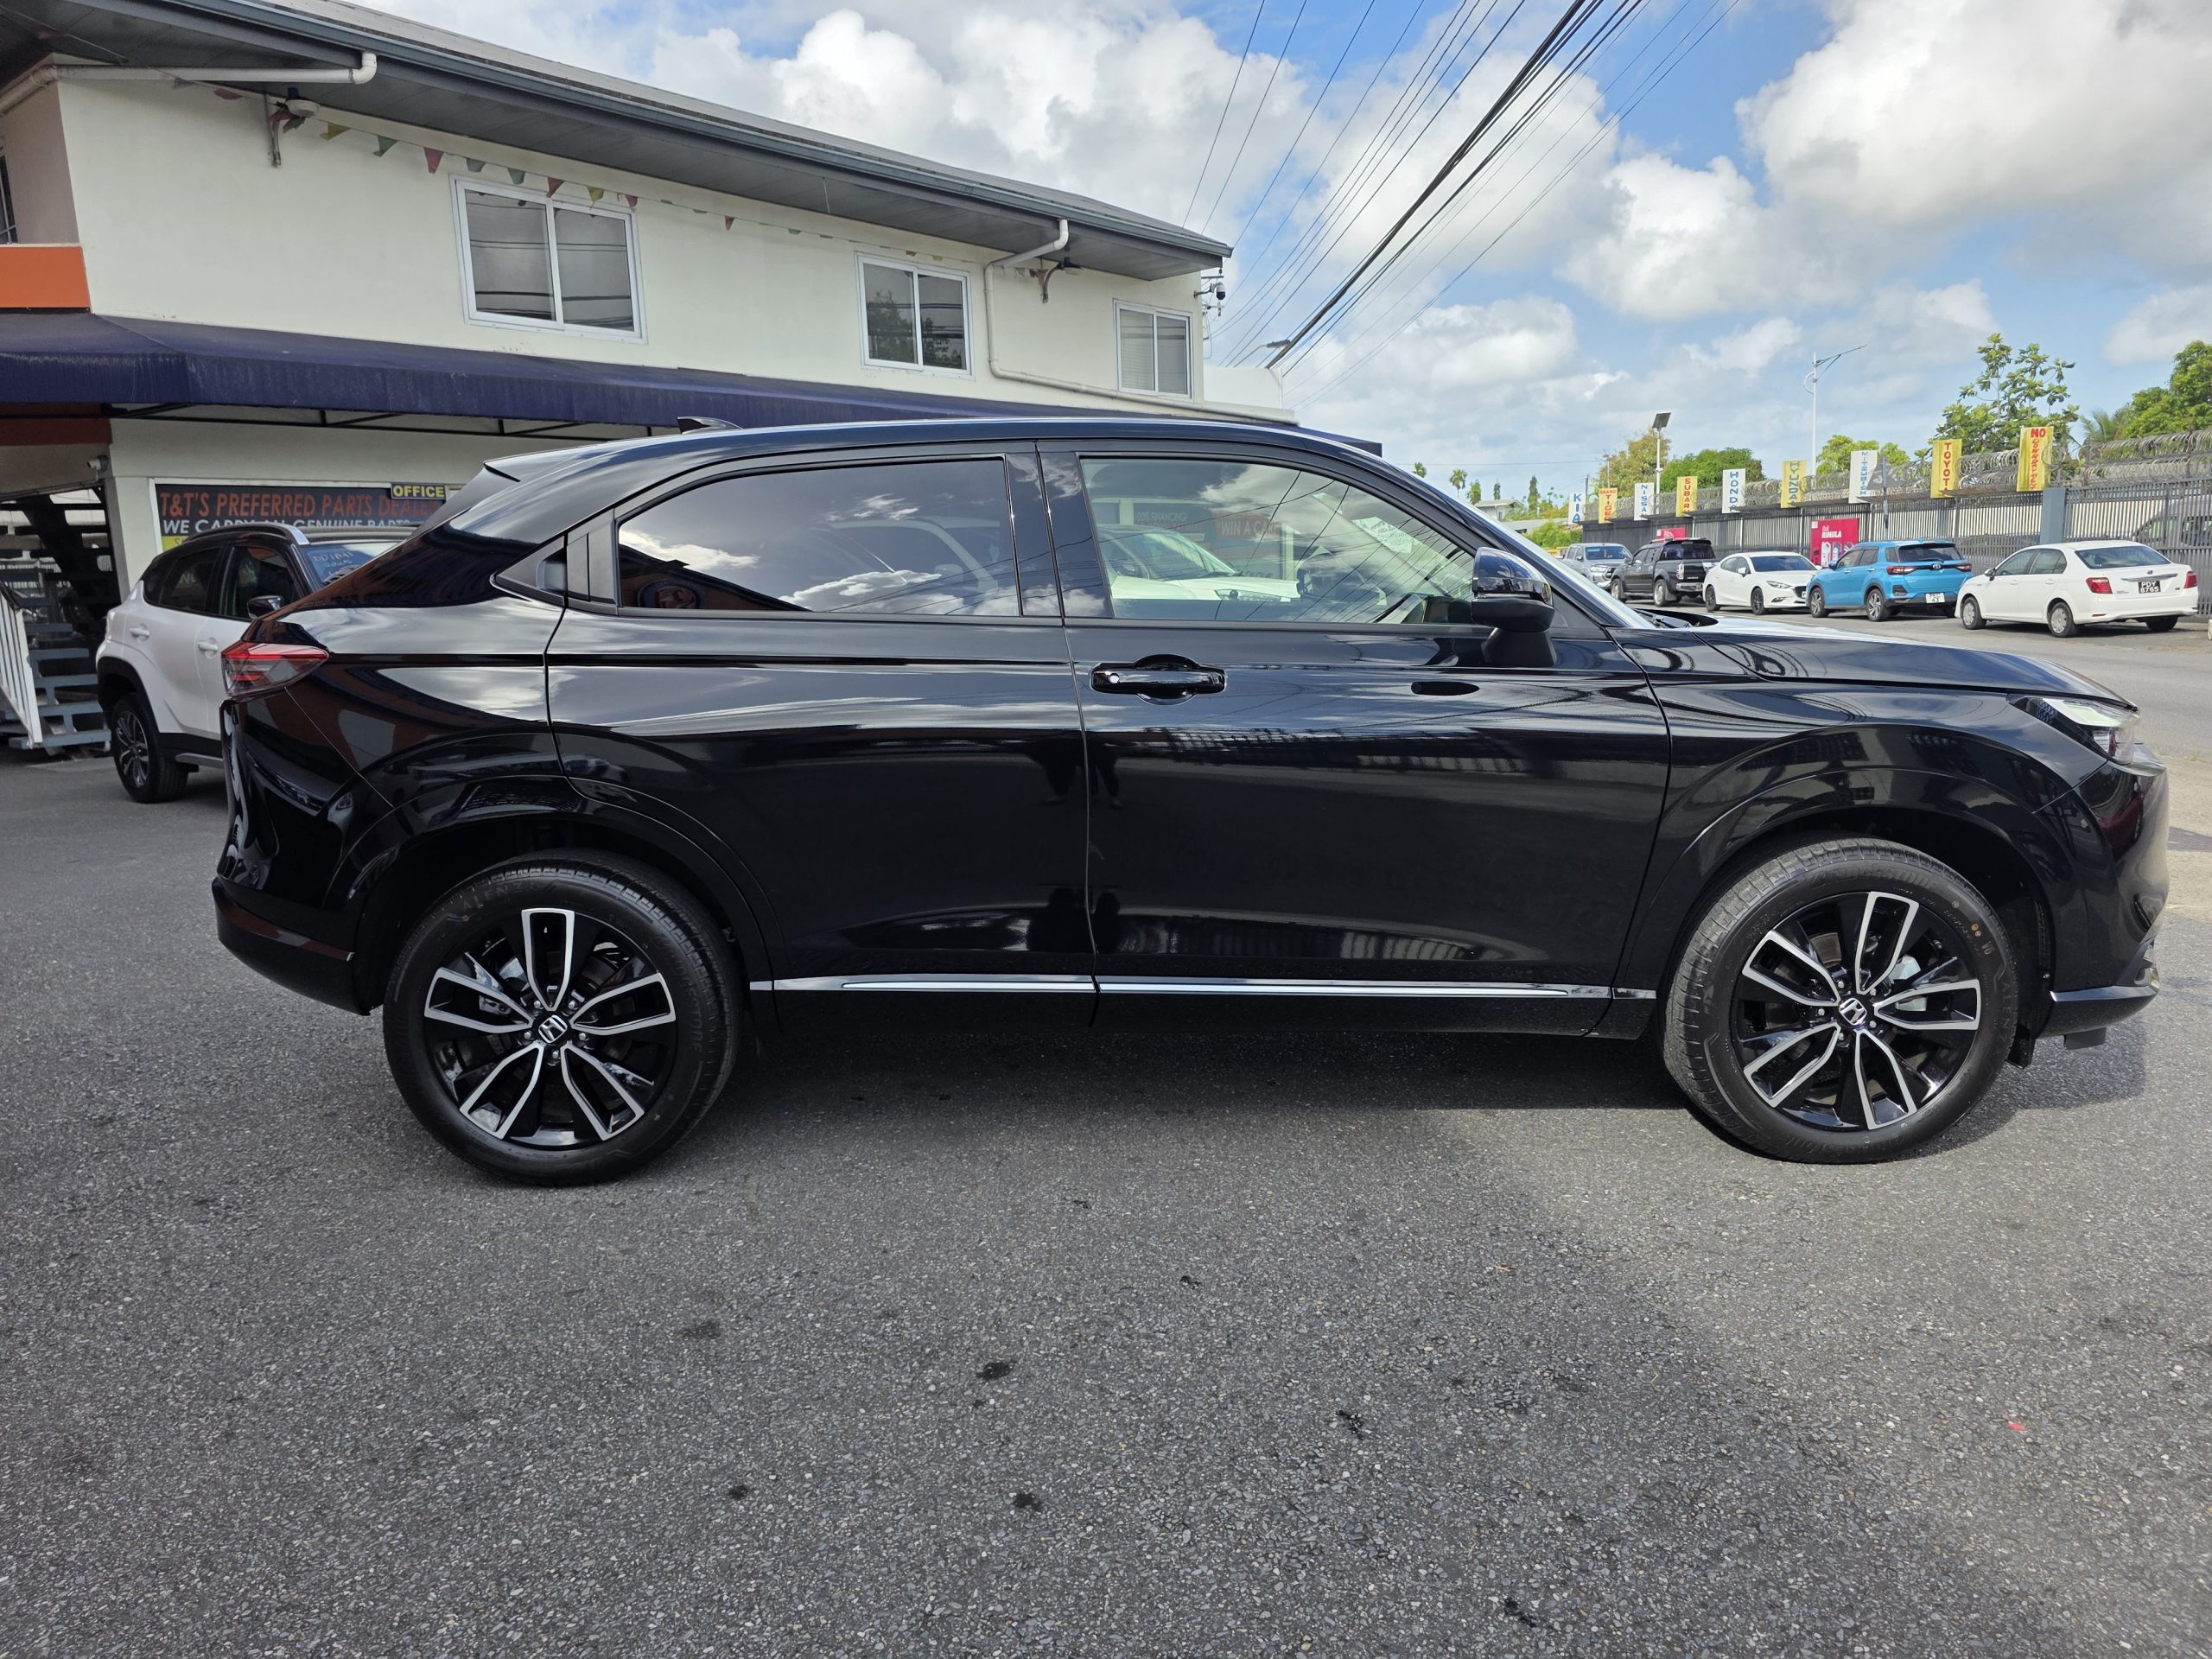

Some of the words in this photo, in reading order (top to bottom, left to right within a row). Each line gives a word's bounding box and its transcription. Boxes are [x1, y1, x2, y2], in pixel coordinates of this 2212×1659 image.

[2031, 429, 2046, 438] NO
[1859, 451, 1868, 496] MITSUBISH
[1942, 442, 1952, 490] TOYOT
[392, 485, 445, 498] OFFICE
[1789, 461, 1800, 501] HYUNDA
[160, 493, 209, 518] T&T'S
[216, 493, 316, 518] PREFERRED
[321, 495, 373, 518] PARTS
[1572, 493, 1582, 522] KIA
[163, 519, 189, 534] WE
[1221, 519, 1241, 536] WIN
[1244, 520, 1251, 535] A
